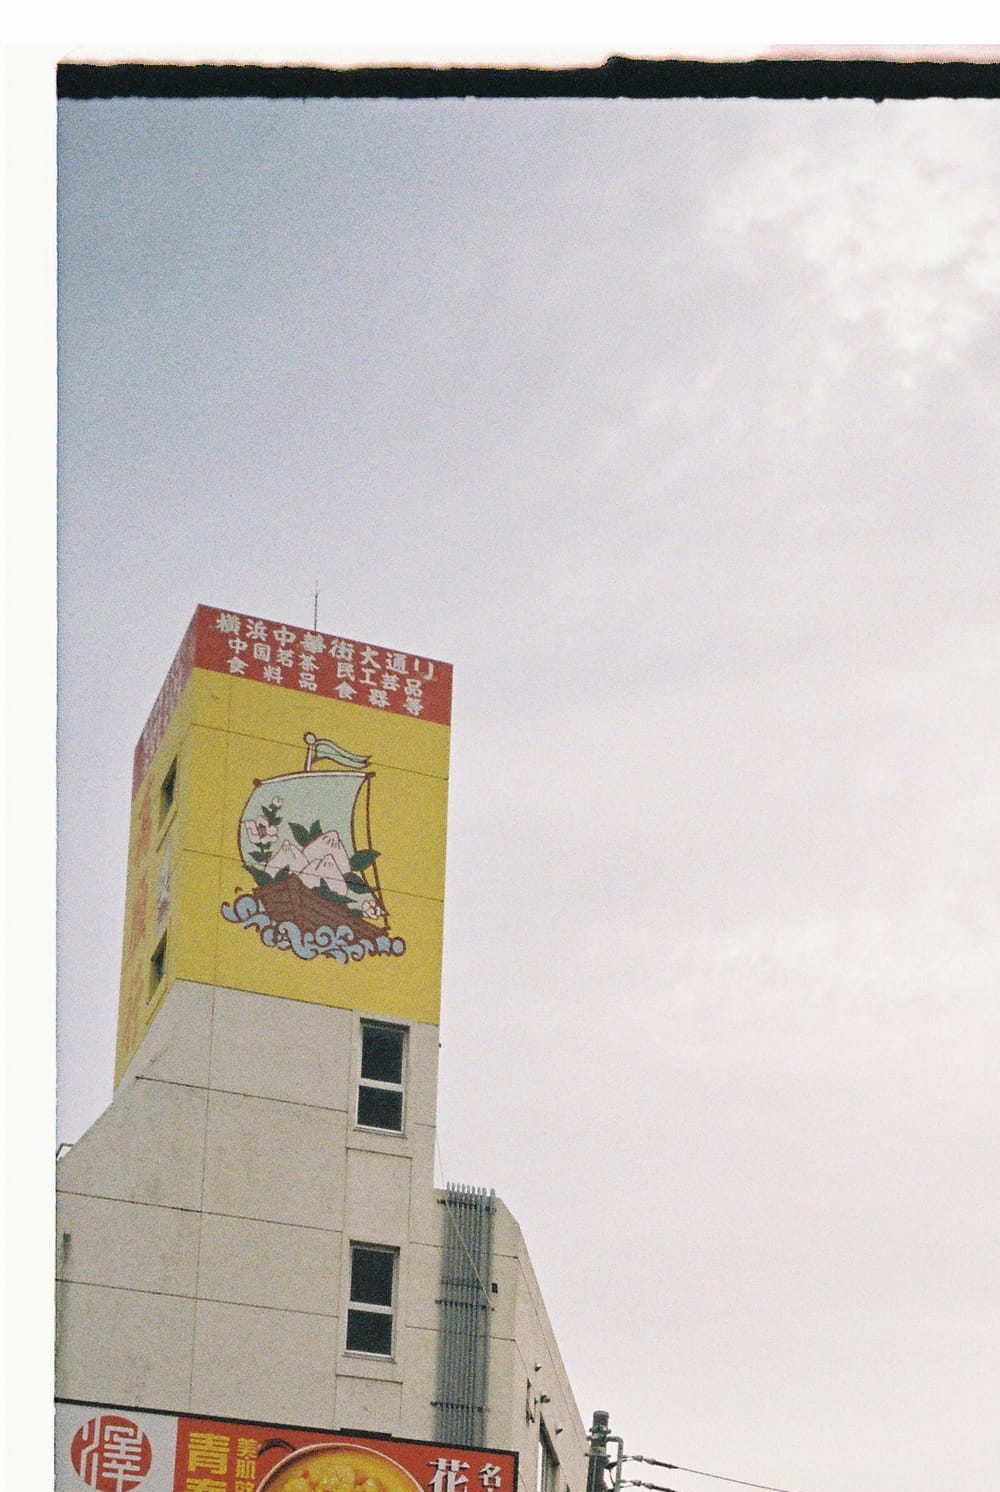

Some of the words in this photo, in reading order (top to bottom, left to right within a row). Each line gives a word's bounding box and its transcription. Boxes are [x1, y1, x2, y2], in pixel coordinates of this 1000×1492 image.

[215, 612, 434, 681] 横浜中華街大通り
[226, 656, 318, 691] 食料品
